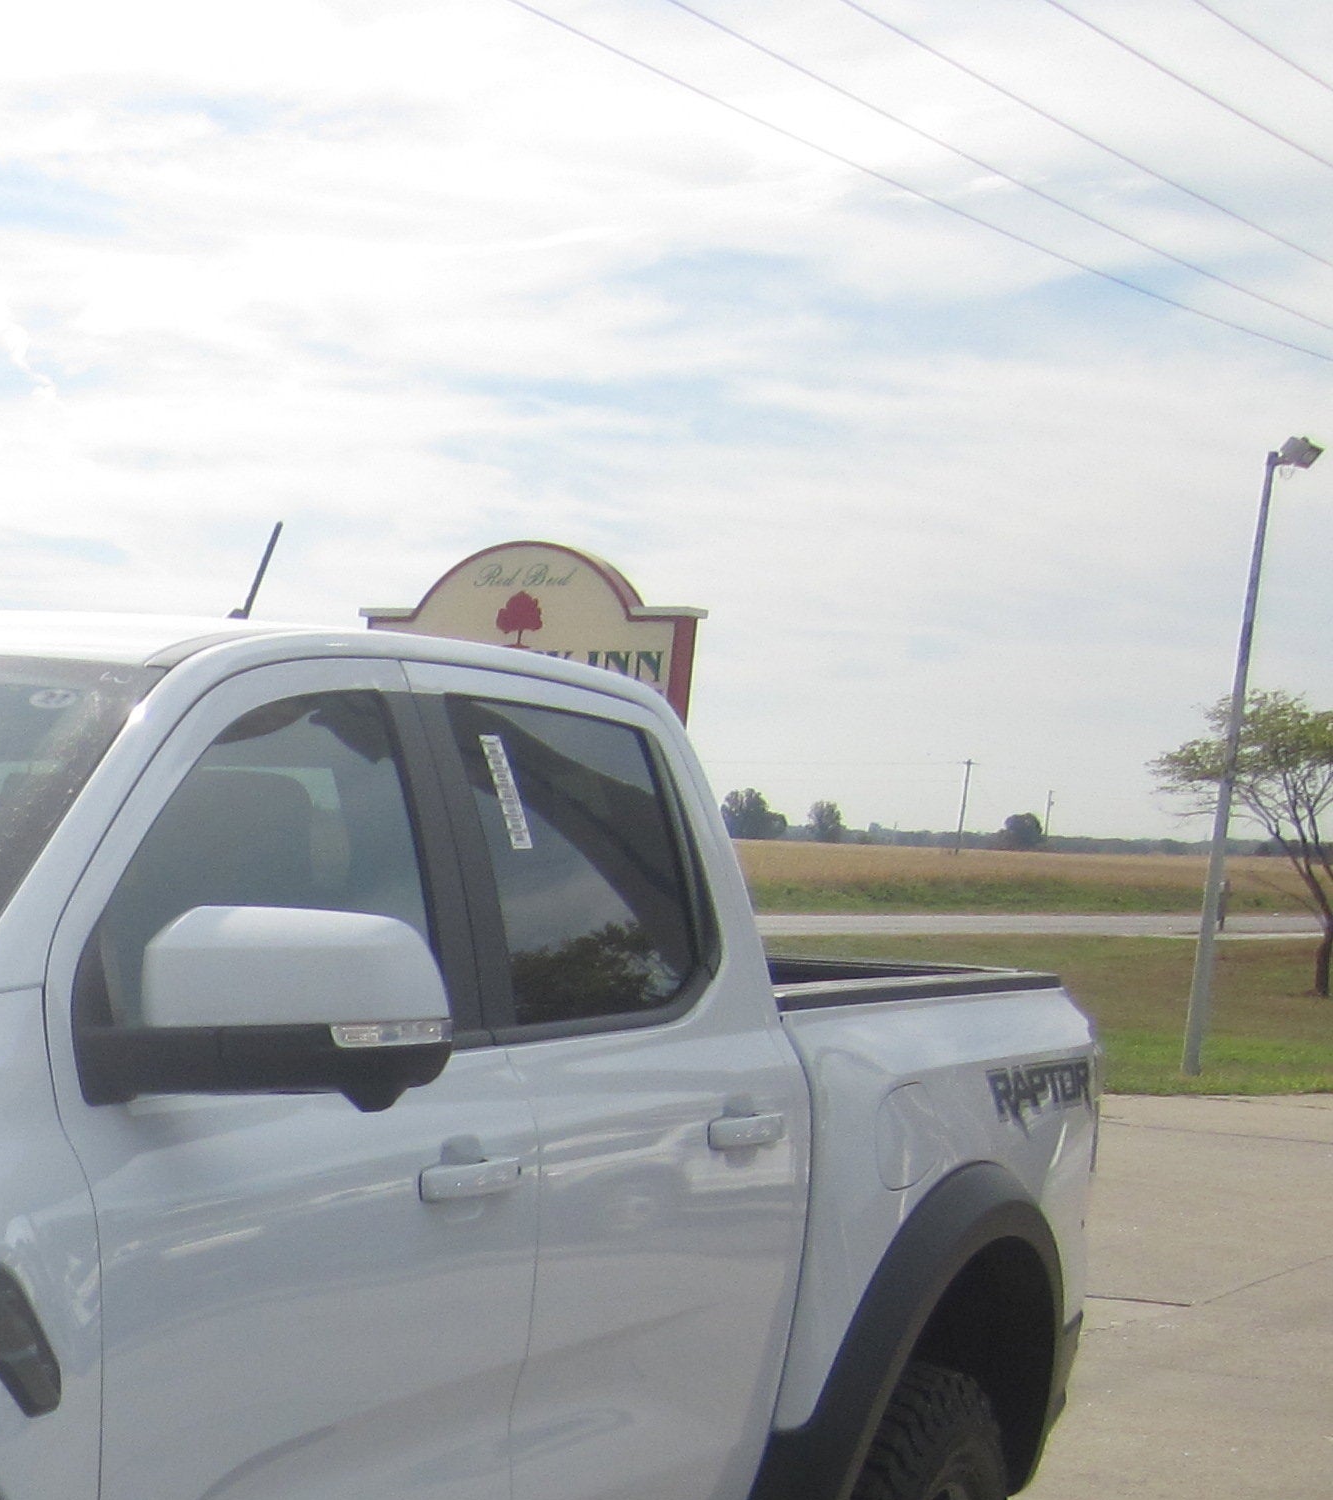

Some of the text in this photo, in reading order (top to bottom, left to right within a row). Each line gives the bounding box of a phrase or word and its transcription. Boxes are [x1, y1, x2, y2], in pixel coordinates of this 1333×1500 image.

[473, 562, 578, 588] Red Bud
[985, 1056, 1093, 1138] RAPTOR
